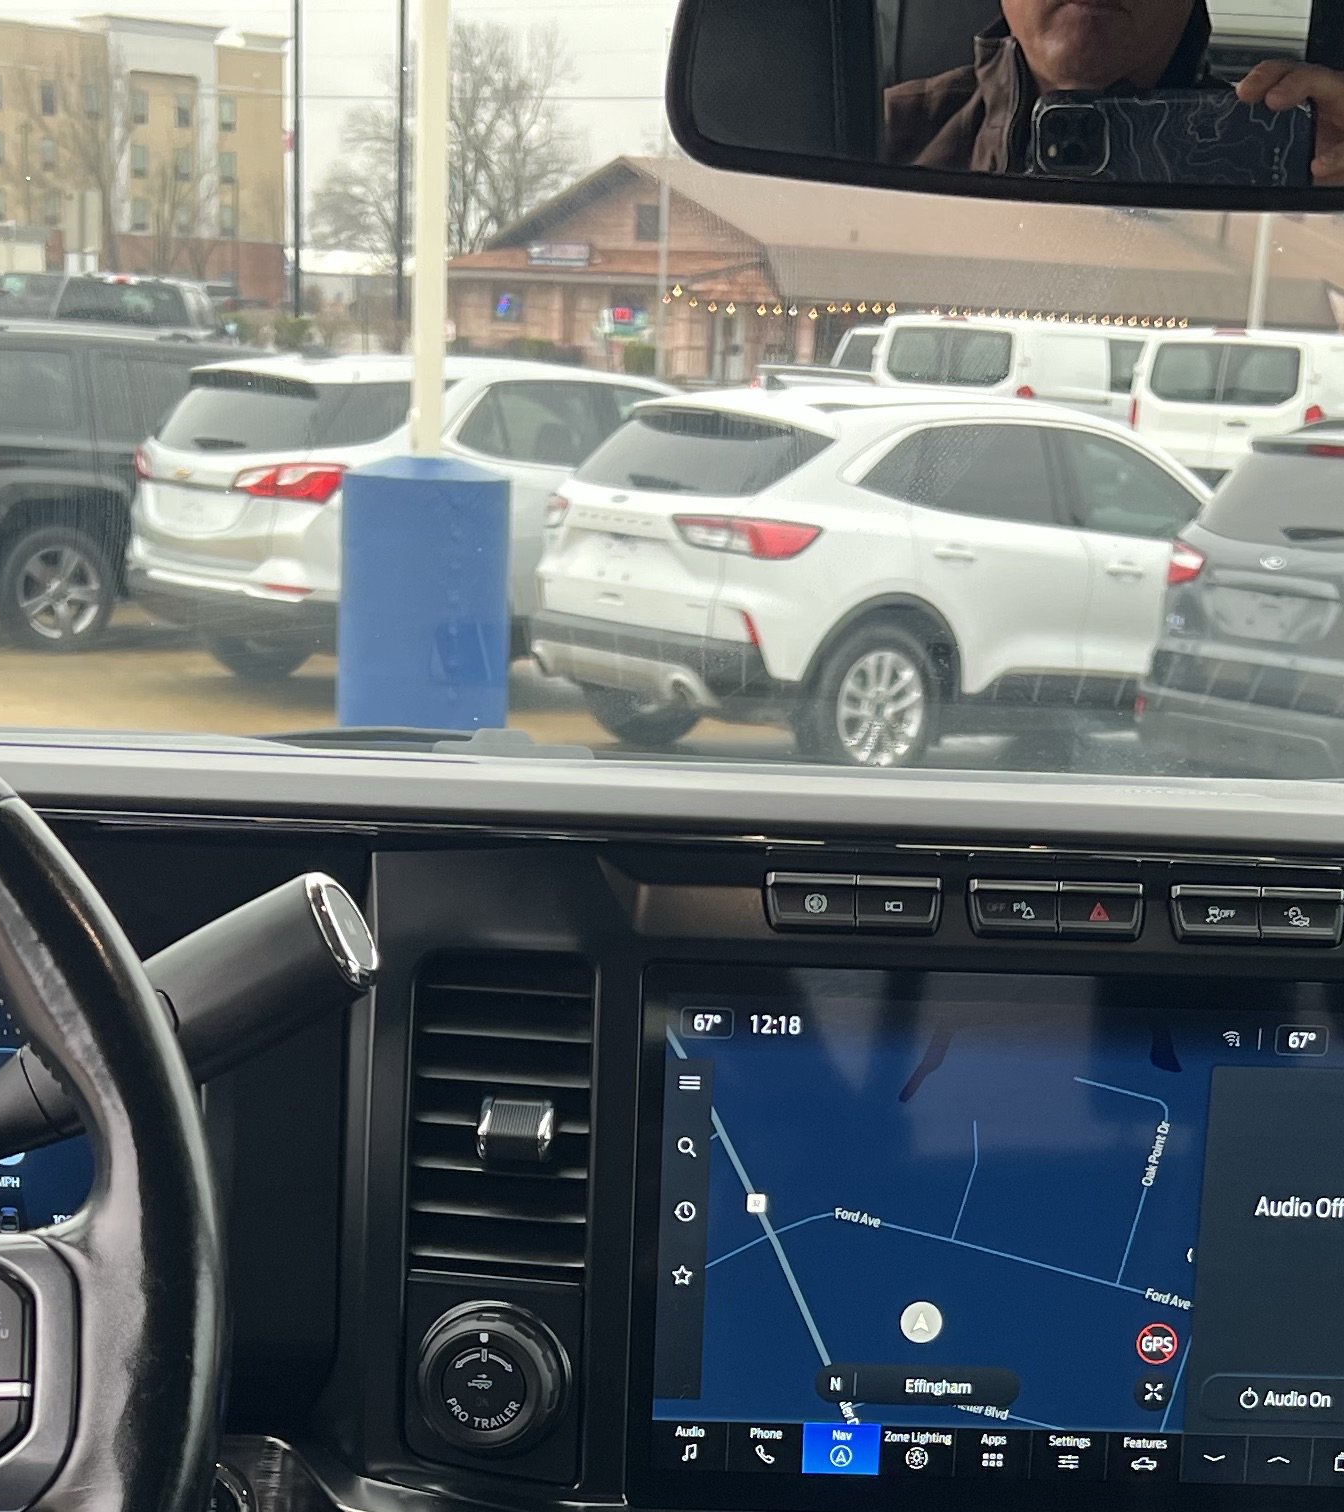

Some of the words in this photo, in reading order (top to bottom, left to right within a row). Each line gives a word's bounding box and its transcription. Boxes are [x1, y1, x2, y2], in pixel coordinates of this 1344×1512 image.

[693, 1013, 722, 1032] 67°
[750, 1014, 801, 1035] 12:18
[1288, 1032, 1317, 1050] 67°
[1157, 1121, 1170, 1135] Dr
[1148, 1134, 1167, 1165] Point
[1141, 1164, 1158, 1187] Oak
[1255, 1196, 1312, 1217] Audio
[834, 1207, 860, 1224] Ford
[860, 1213, 882, 1228] Ave
[1145, 1287, 1169, 1304] Ford
[1169, 1294, 1192, 1310] Ave
[1141, 1335, 1174, 1353] GPS
[830, 1377, 842, 1391] N
[905, 1378, 972, 1396] Effingham
[1264, 1391, 1307, 1407] Audio
[1309, 1391, 1331, 1408] On
[447, 1397, 470, 1422] PRO
[473, 1401, 521, 1429] TRAILER
[984, 1405, 1009, 1420] Blvd
[675, 1426, 706, 1438] Audio
[750, 1428, 783, 1440] Phone
[832, 1429, 852, 1441] Nav
[884, 1431, 910, 1443] Zone
[911, 1431, 952, 1447] Lighting
[980, 1434, 1007, 1447] Apps
[1049, 1435, 1091, 1449] Settings
[1123, 1437, 1168, 1450] Features
